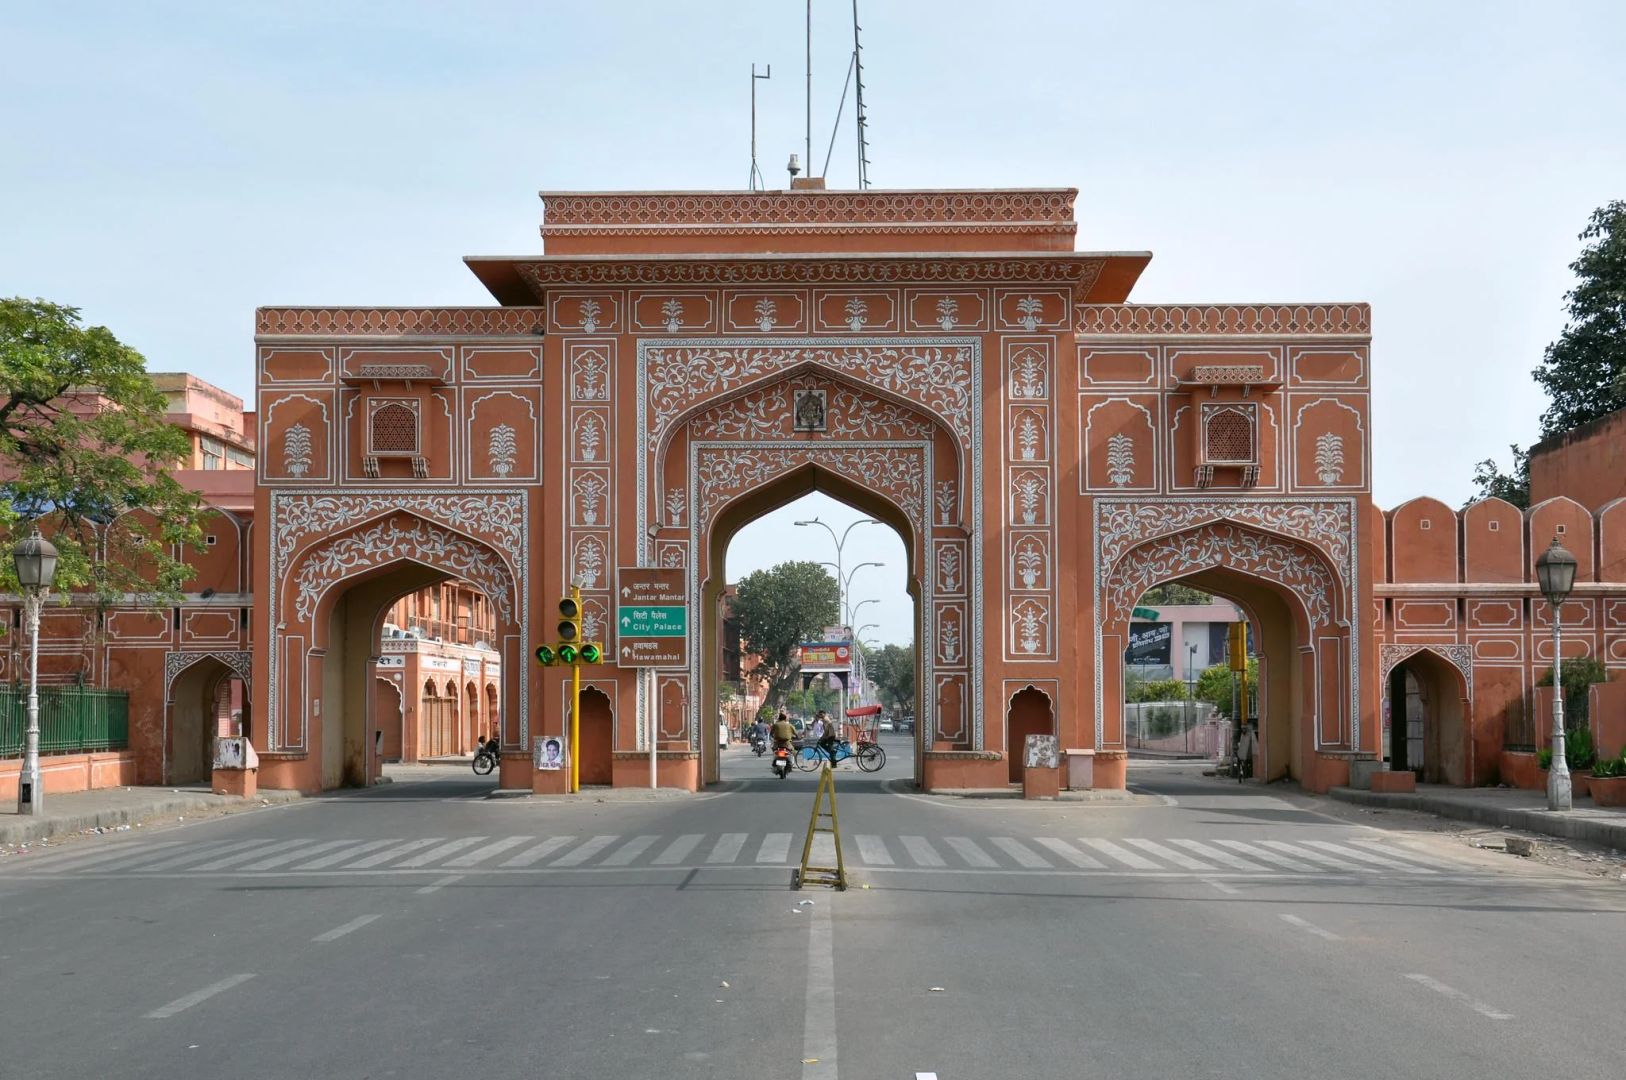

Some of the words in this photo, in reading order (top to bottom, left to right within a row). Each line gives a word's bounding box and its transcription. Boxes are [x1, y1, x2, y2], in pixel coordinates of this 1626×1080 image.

[633, 610, 648, 620] सिटी
[651, 610, 667, 620] पैलेस
[633, 623, 650, 631] City
[633, 653, 680, 661] Hawamahal
